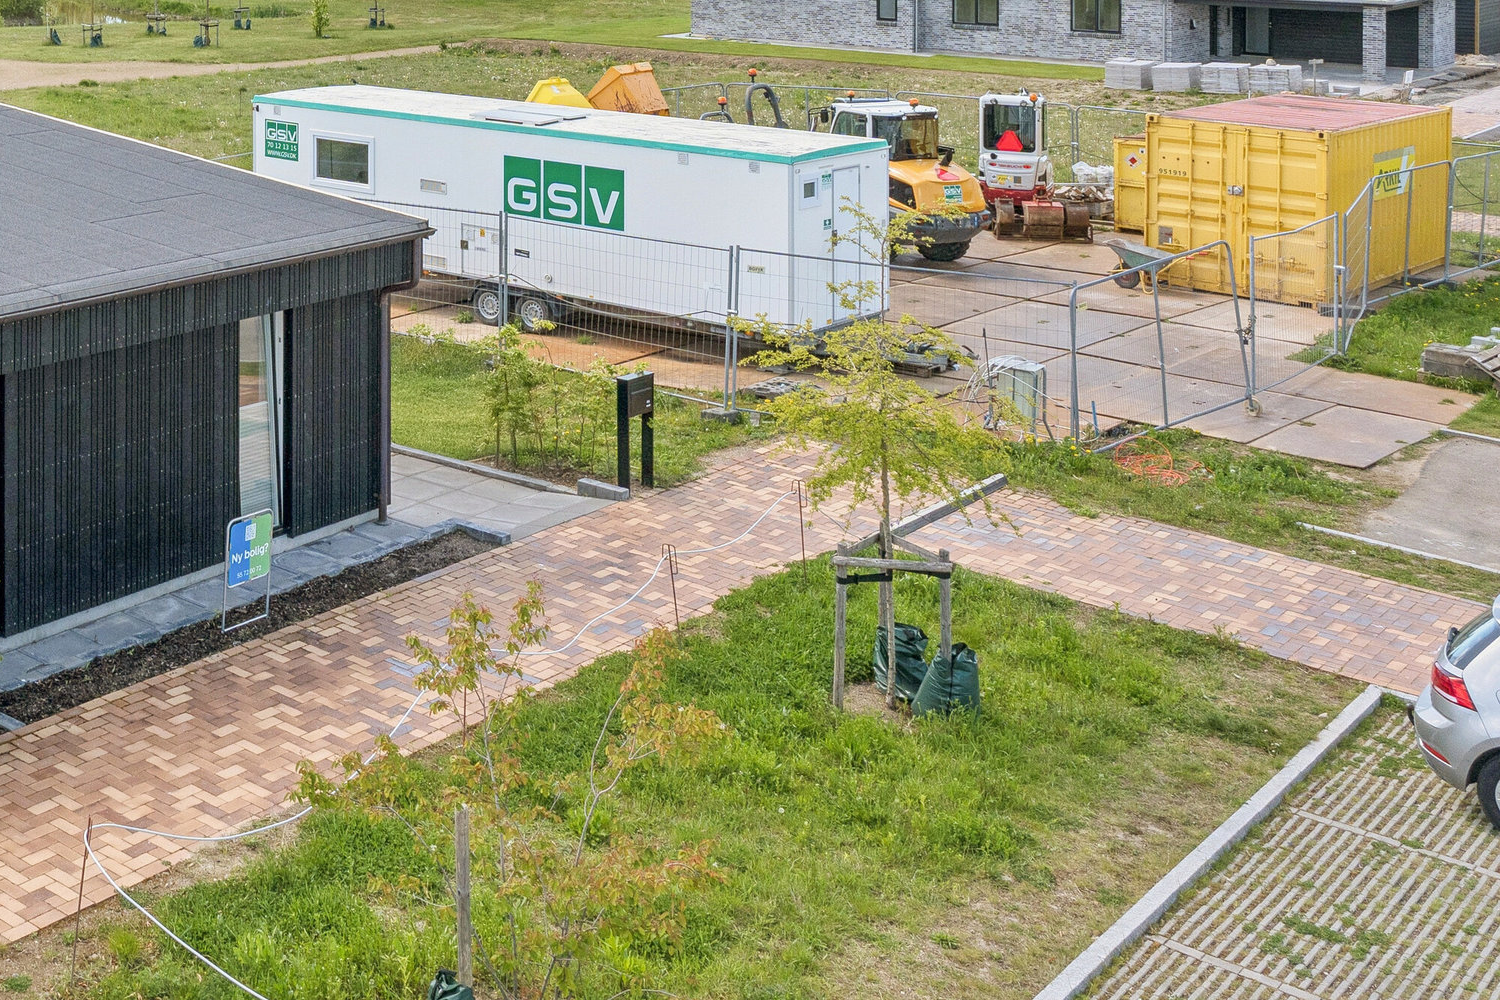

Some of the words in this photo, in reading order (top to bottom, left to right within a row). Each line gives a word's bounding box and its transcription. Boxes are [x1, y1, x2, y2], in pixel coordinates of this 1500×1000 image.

[267, 127, 296, 141] GSV
[1158, 167, 1187, 176] 951919
[507, 177, 620, 224] GSV
[231, 552, 243, 564] Ny
[244, 542, 269, 560] bolig?
